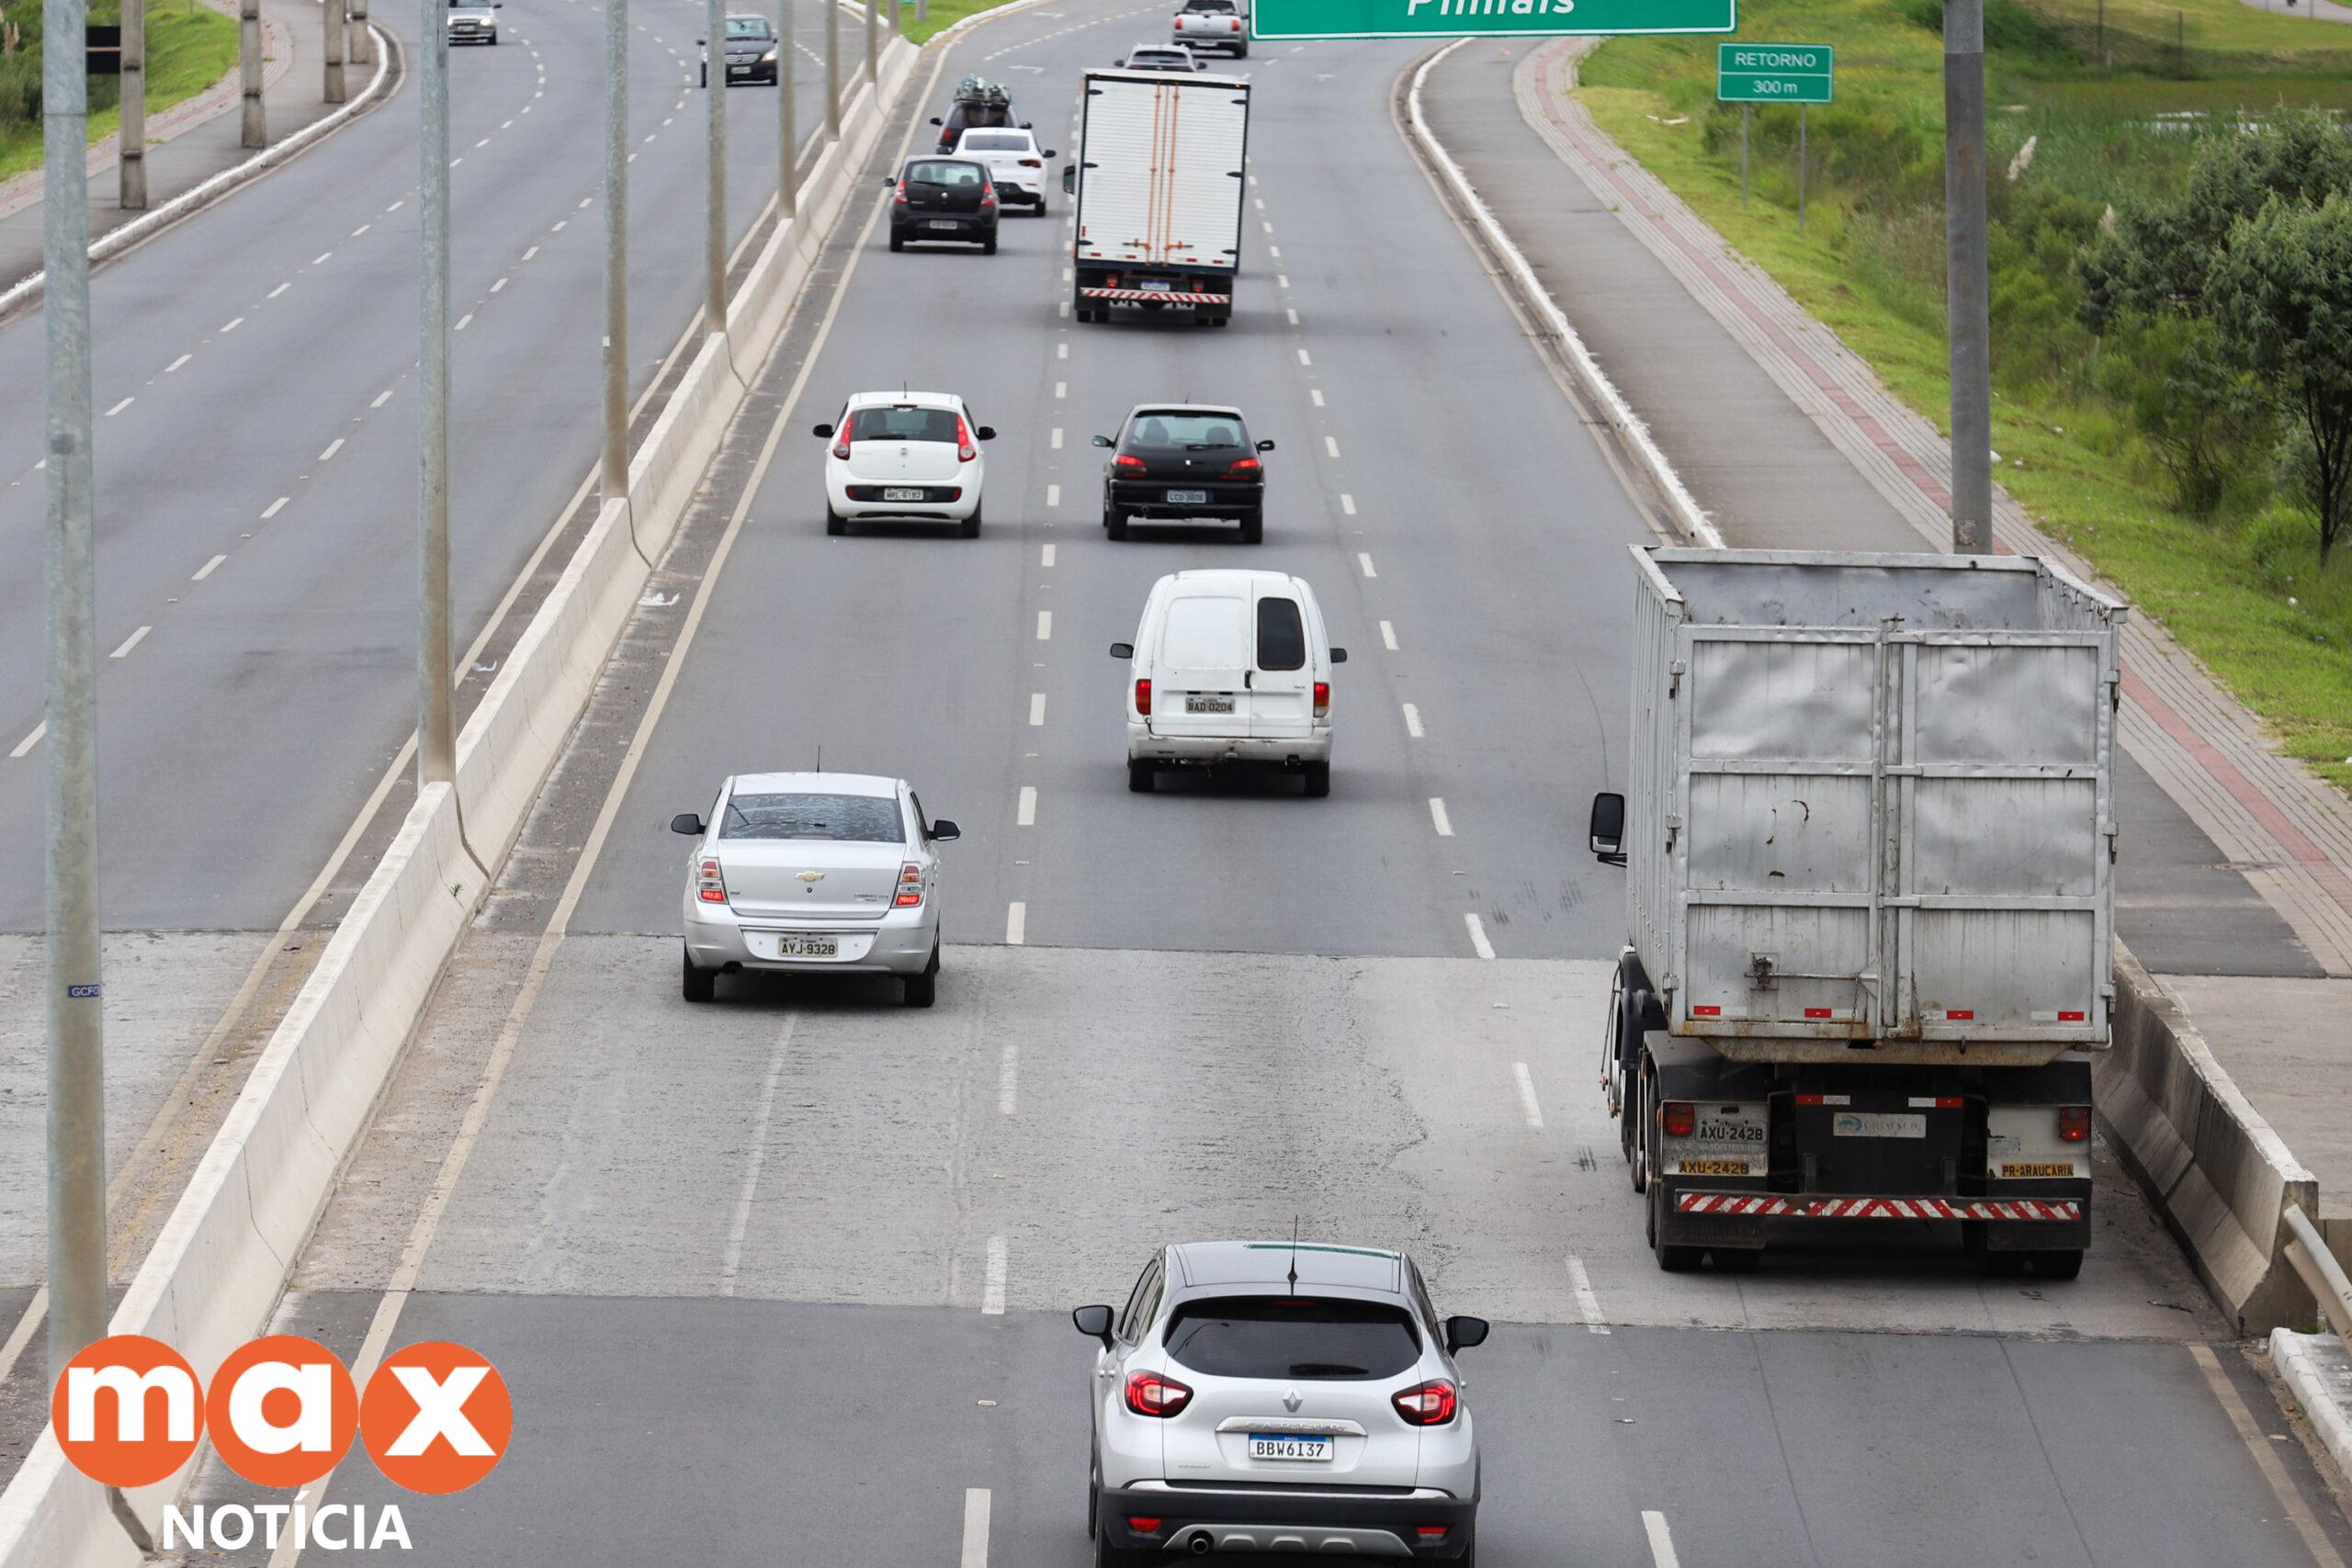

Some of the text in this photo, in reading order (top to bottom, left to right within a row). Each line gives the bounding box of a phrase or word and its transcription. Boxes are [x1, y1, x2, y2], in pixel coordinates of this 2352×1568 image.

[1735, 52, 1816, 68] RETORNO
[1753, 80, 1798, 94] 300 m
